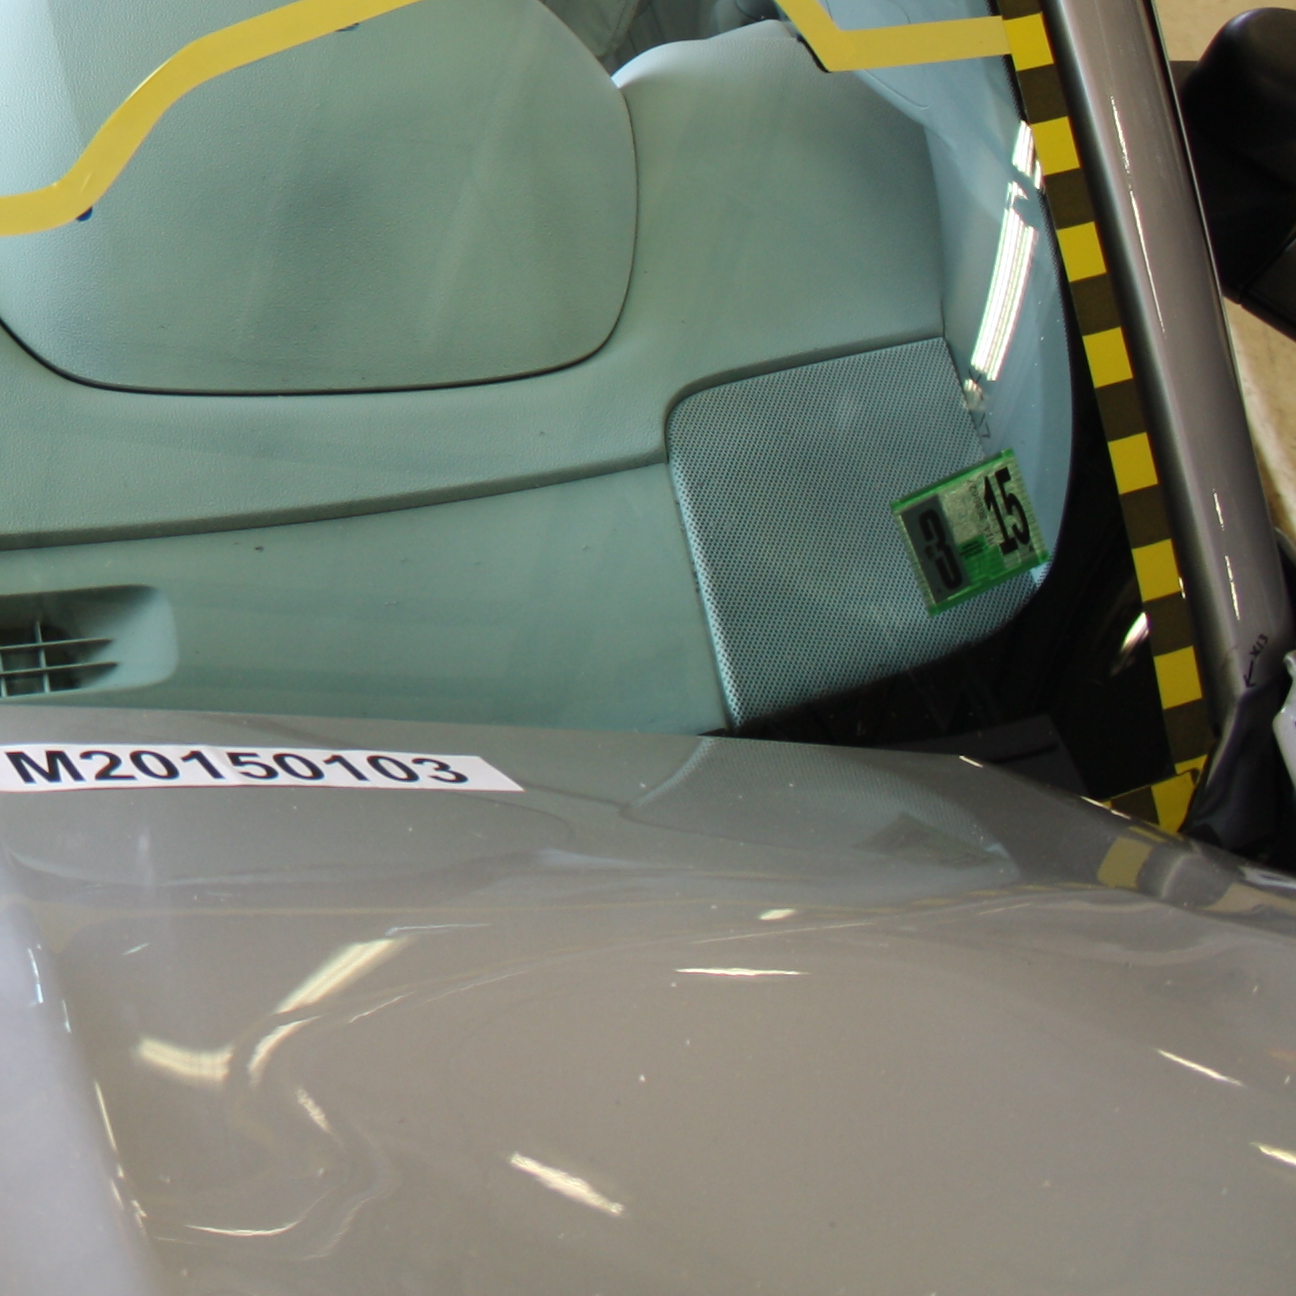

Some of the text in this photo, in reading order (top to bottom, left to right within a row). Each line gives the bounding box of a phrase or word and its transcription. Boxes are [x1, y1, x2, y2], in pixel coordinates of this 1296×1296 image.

[918, 508, 964, 591] 3
[982, 466, 1031, 556] 15
[4, 749, 470, 785] M20150103
